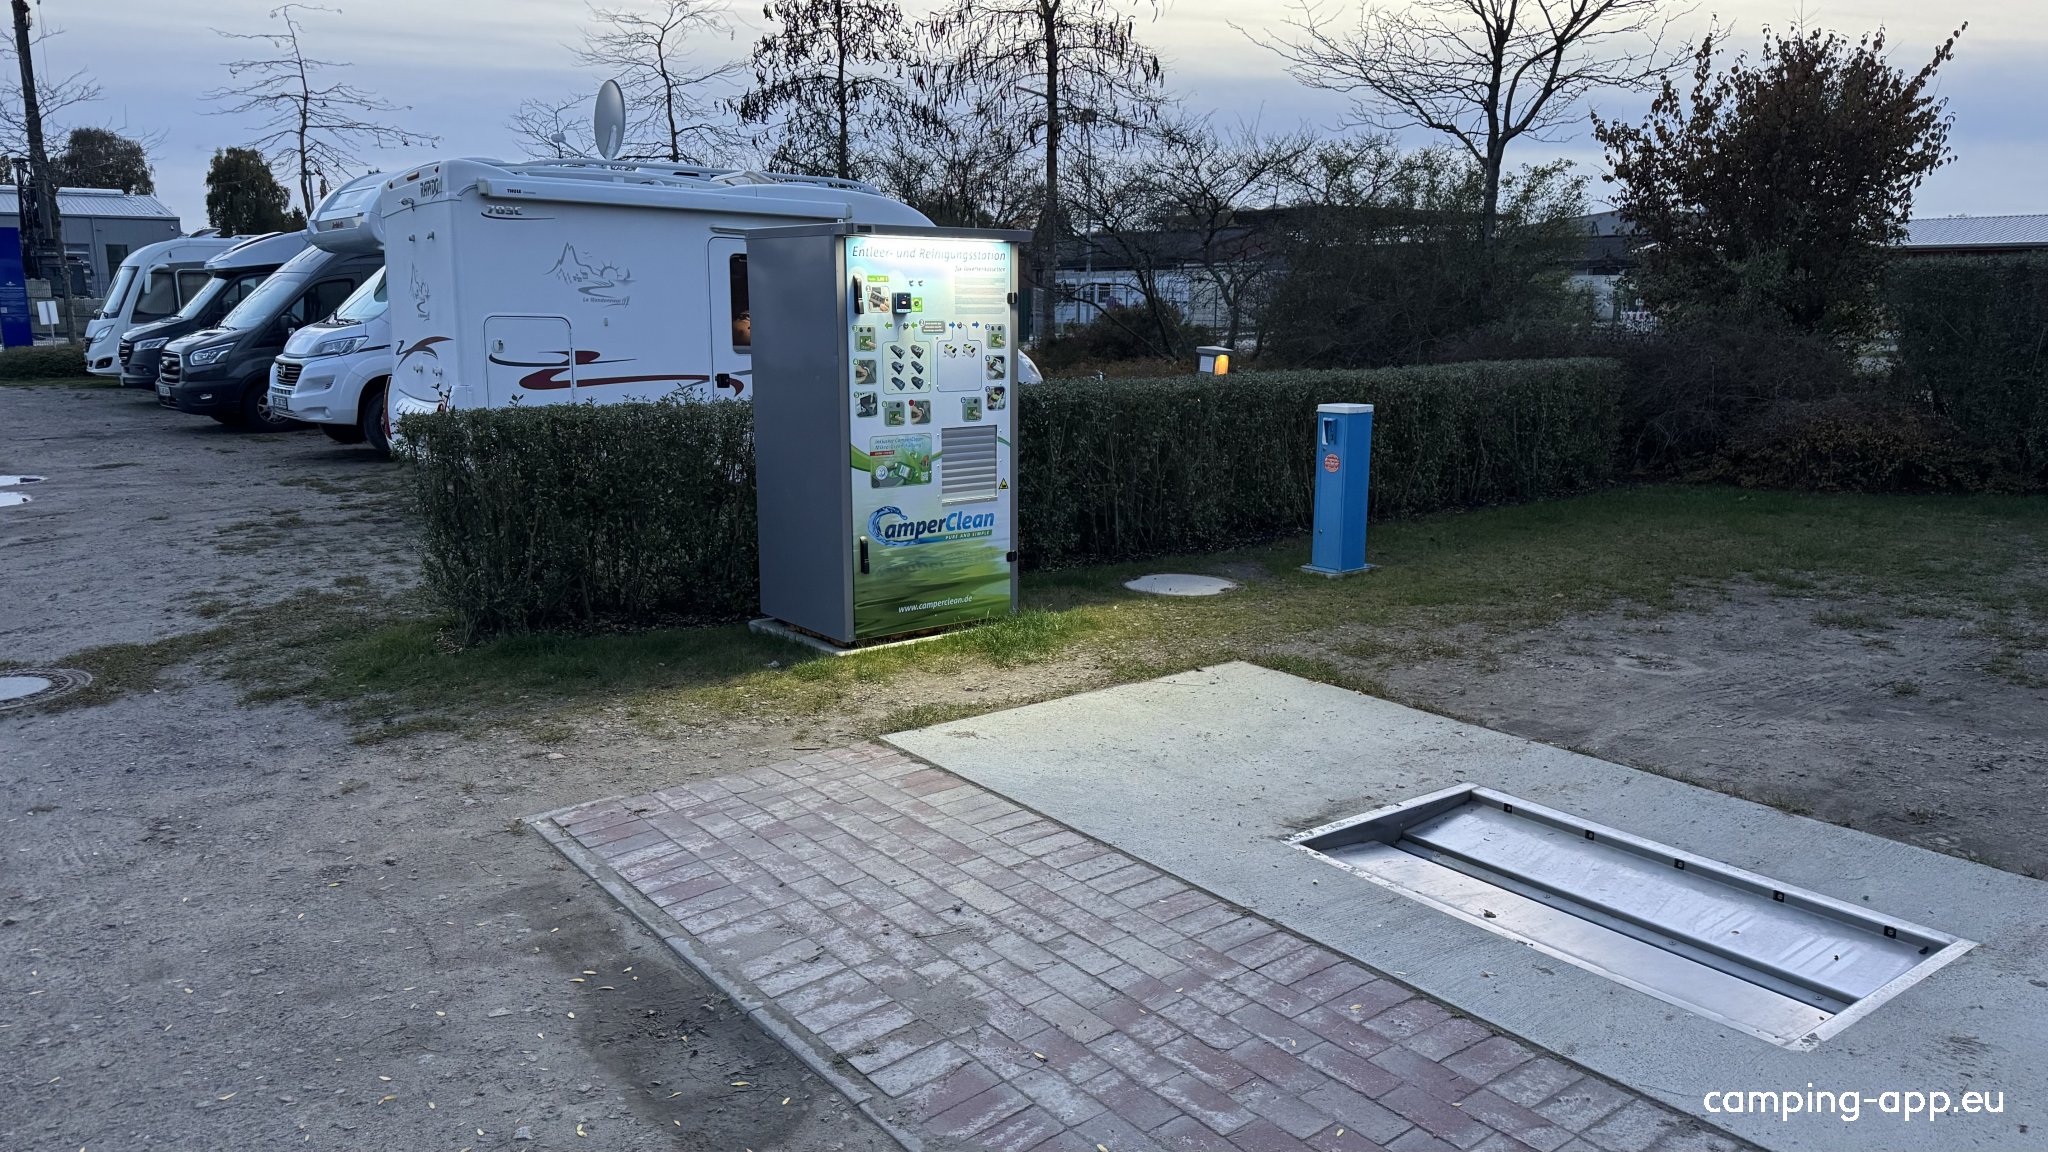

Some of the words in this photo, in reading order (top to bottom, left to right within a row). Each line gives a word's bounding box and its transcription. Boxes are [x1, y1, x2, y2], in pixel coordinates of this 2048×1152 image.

[852, 246, 893, 258] Entleer-
[896, 248, 916, 258] und
[919, 248, 1006, 263] Reinigungsstation
[868, 506, 995, 545] CamperClean
[898, 594, 973, 613] www.camperclean.de
